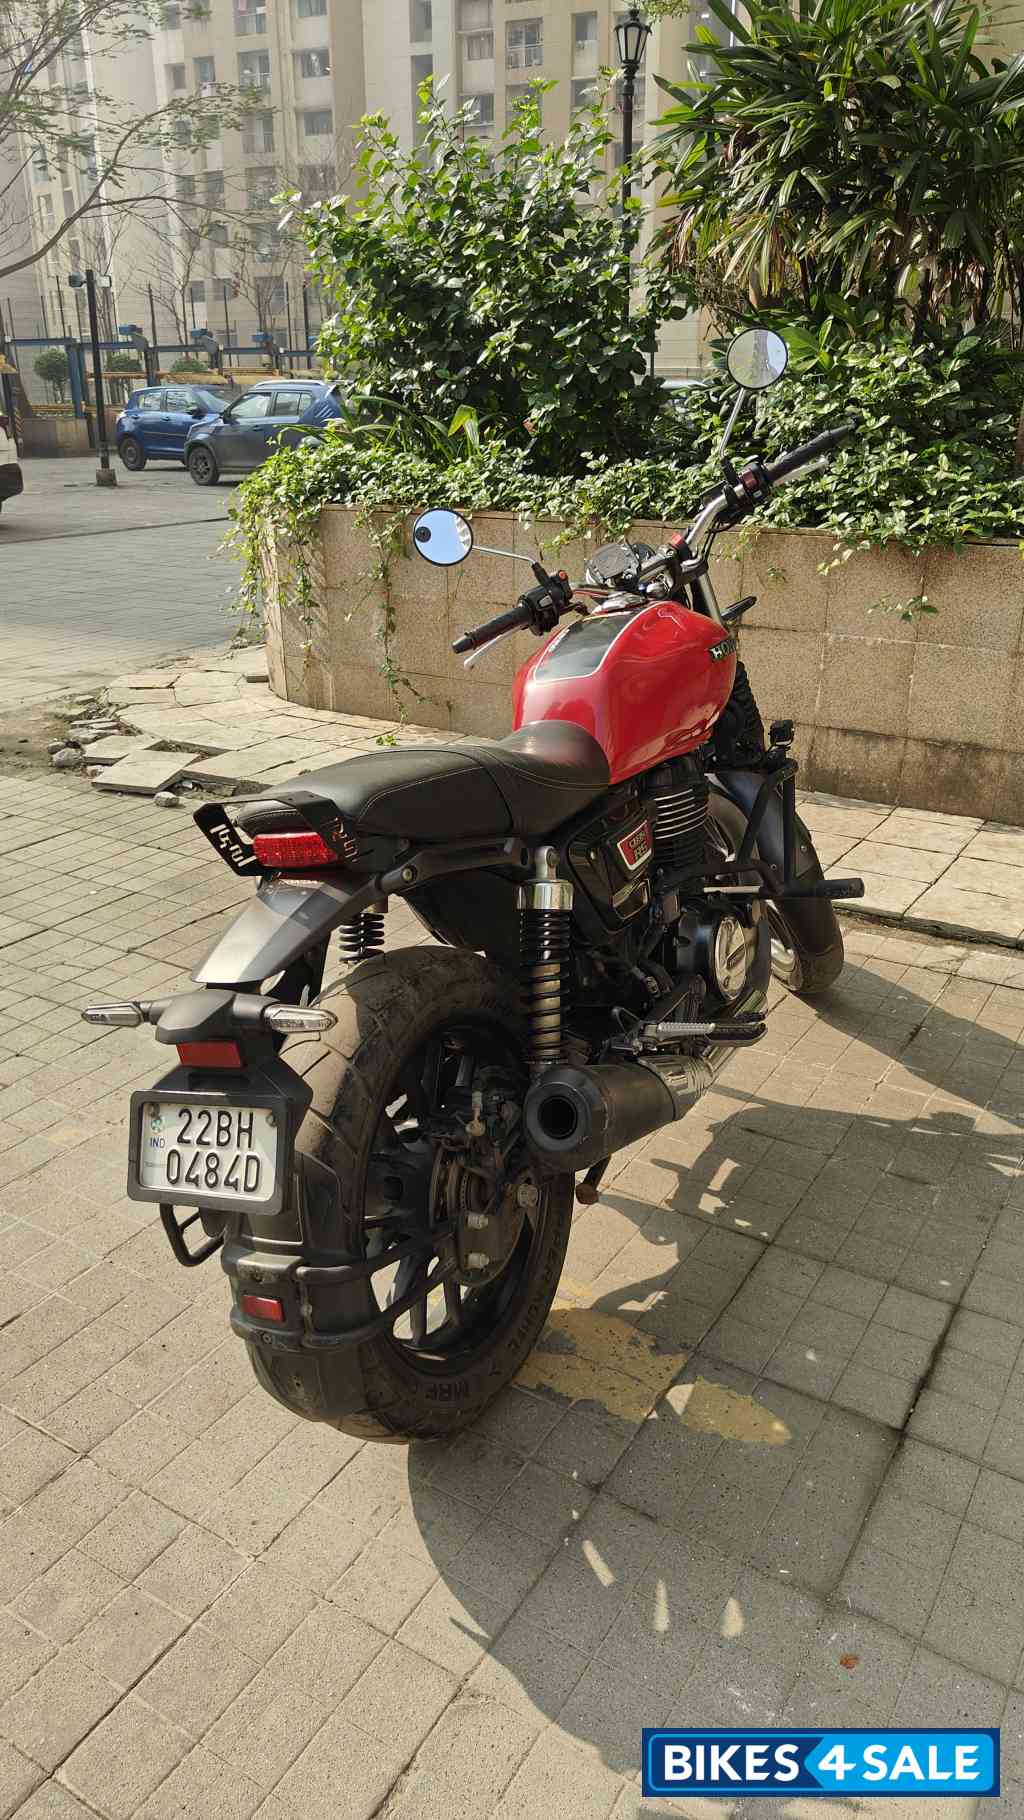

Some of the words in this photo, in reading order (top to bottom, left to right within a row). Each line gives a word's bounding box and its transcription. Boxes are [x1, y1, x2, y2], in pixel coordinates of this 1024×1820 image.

[150, 1137, 165, 1149] IND
[177, 1108, 254, 1149] 22BH
[166, 1149, 260, 1192] 0484D
